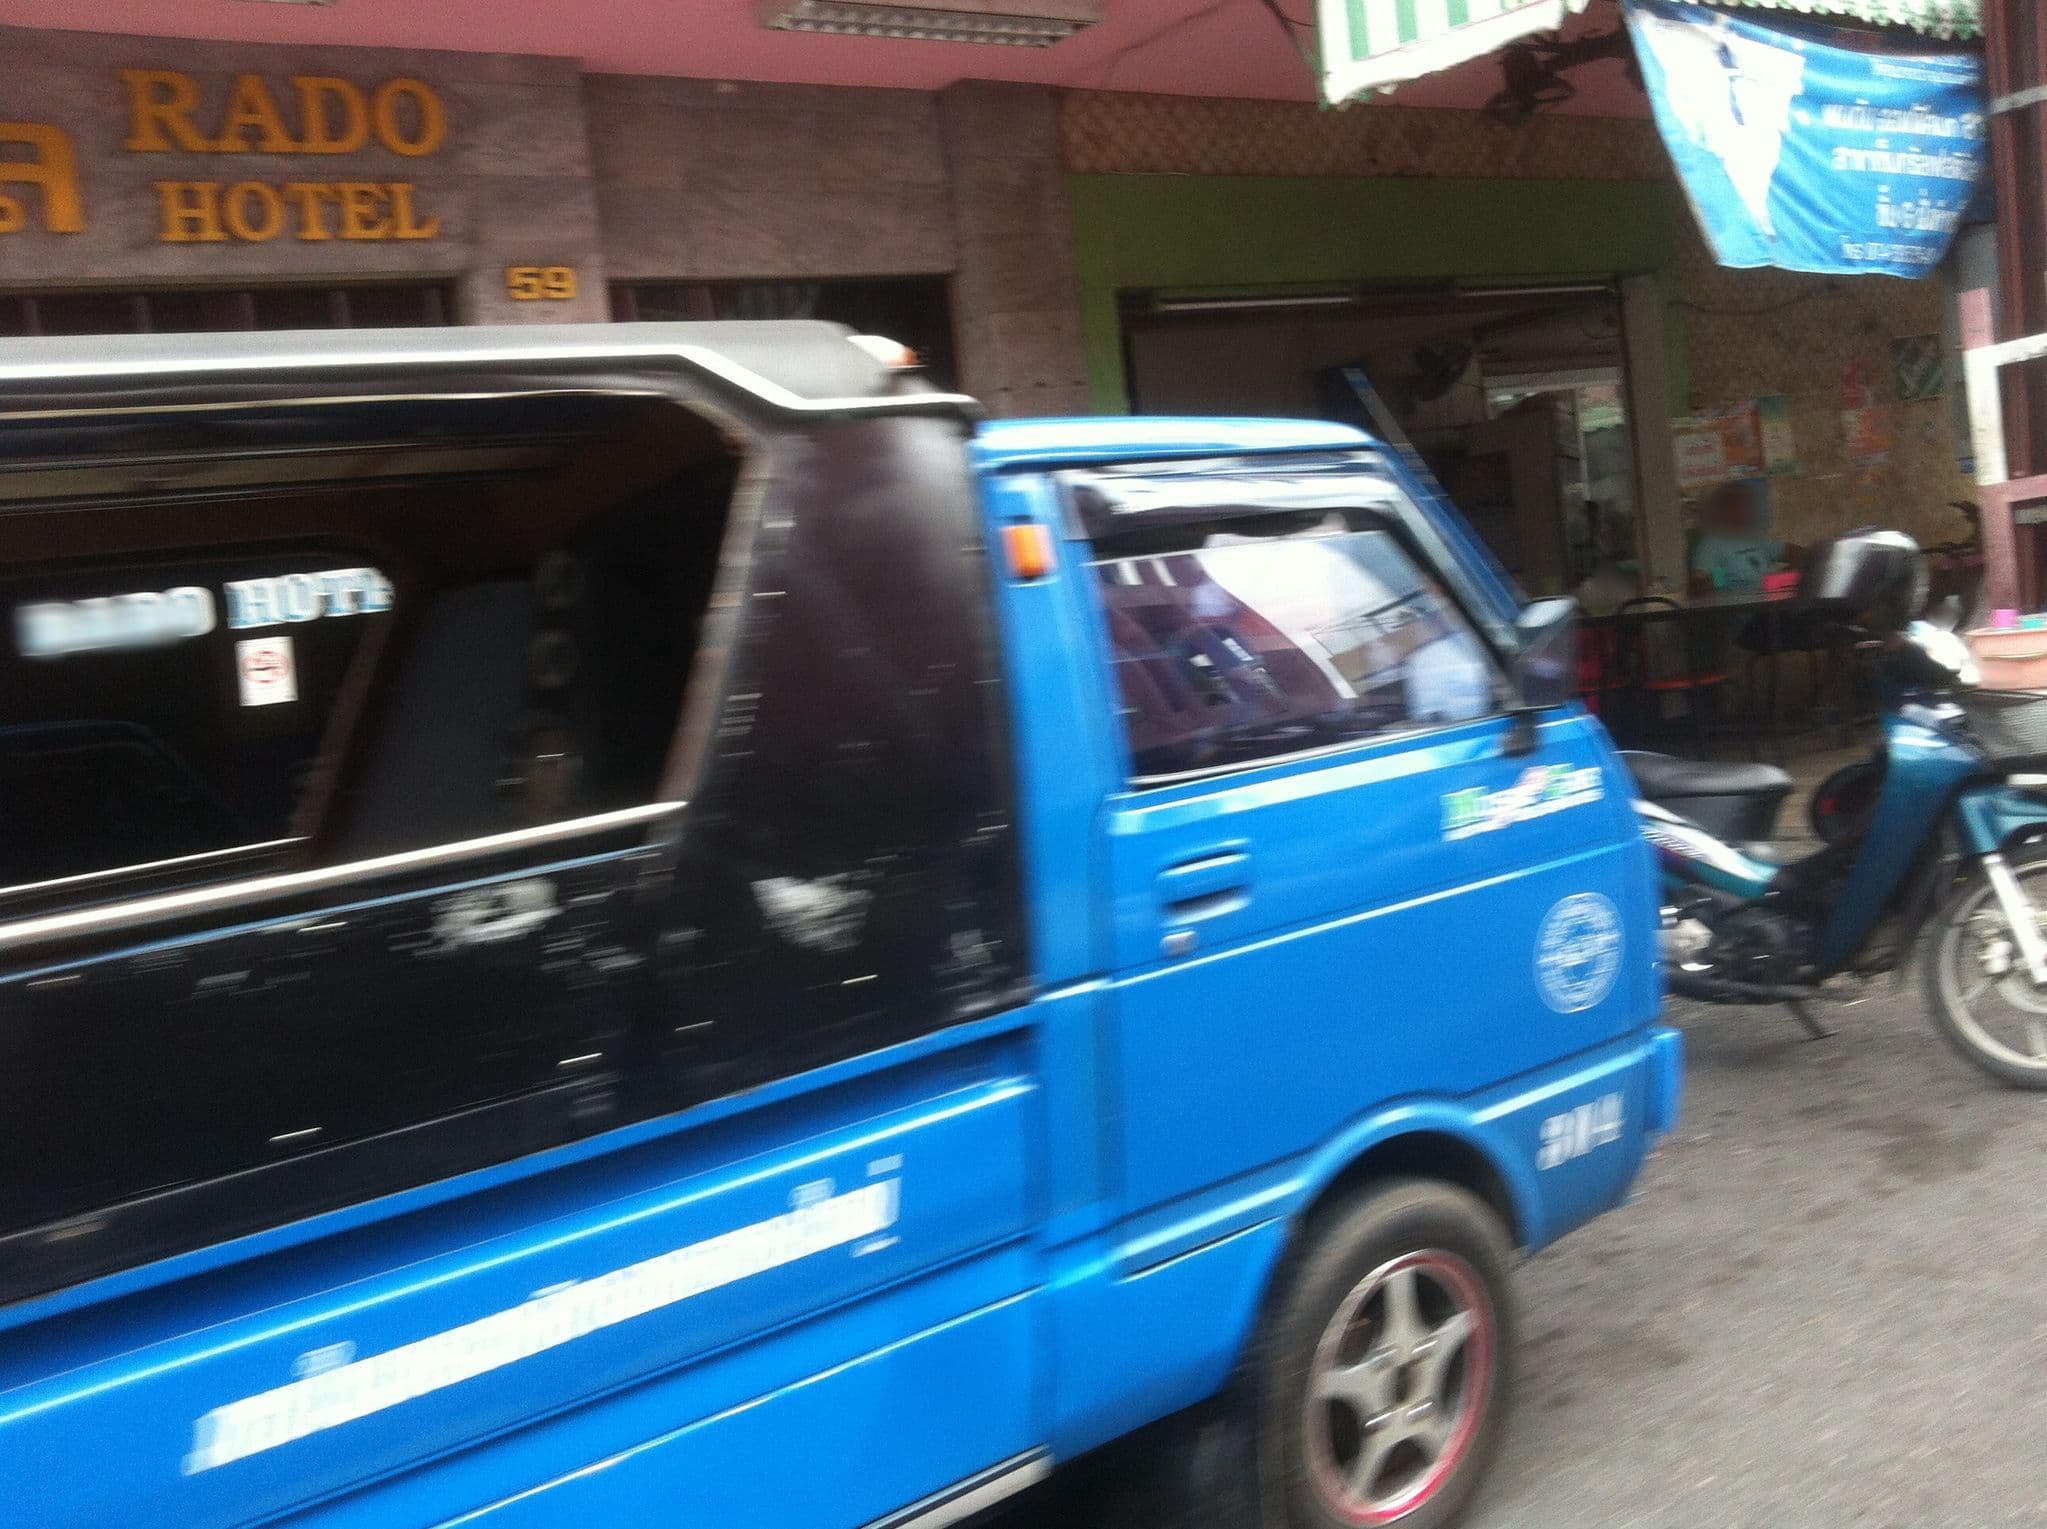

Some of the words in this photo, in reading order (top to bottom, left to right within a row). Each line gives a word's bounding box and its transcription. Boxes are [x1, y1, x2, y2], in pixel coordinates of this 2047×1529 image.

[117, 68, 448, 156] RADO
[156, 181, 441, 241] HOTEL
[504, 266, 577, 300] 59
